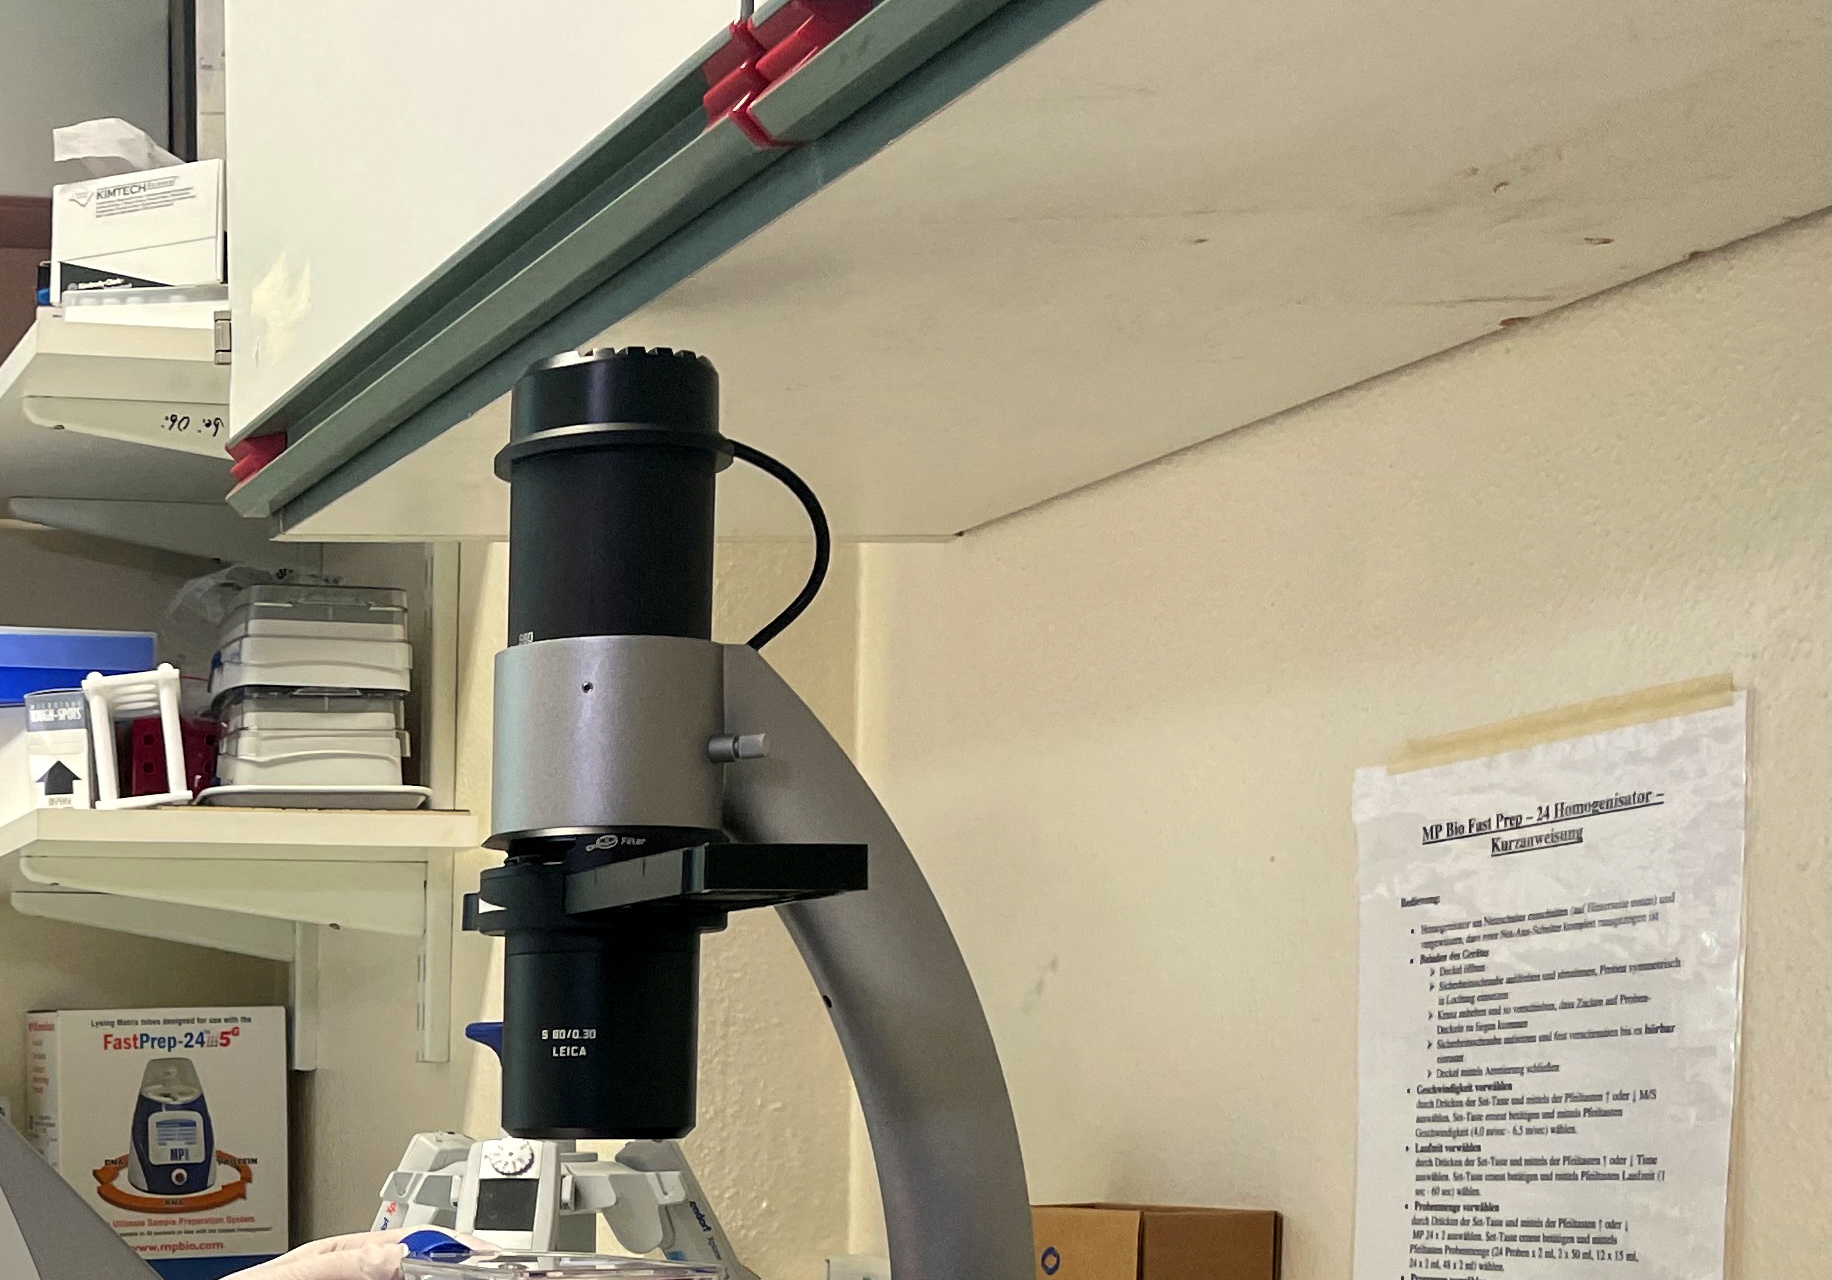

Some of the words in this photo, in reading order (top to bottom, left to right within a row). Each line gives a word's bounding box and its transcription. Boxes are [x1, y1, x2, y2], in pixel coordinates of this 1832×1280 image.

[1422, 825, 1442, 840] MP
[1446, 823, 1464, 837] Bio
[1468, 818, 1491, 833] Fast
[1496, 813, 1522, 830] Prep
[1536, 805, 1550, 821] 24
[1554, 790, 1652, 819] Homogenisator
[1491, 827, 1583, 853] Kurzanweisung
[552, 1046, 587, 1057] LEICA
[148, 1218, 176, 1227] Sample
[179, 1217, 224, 1227] Preparation
